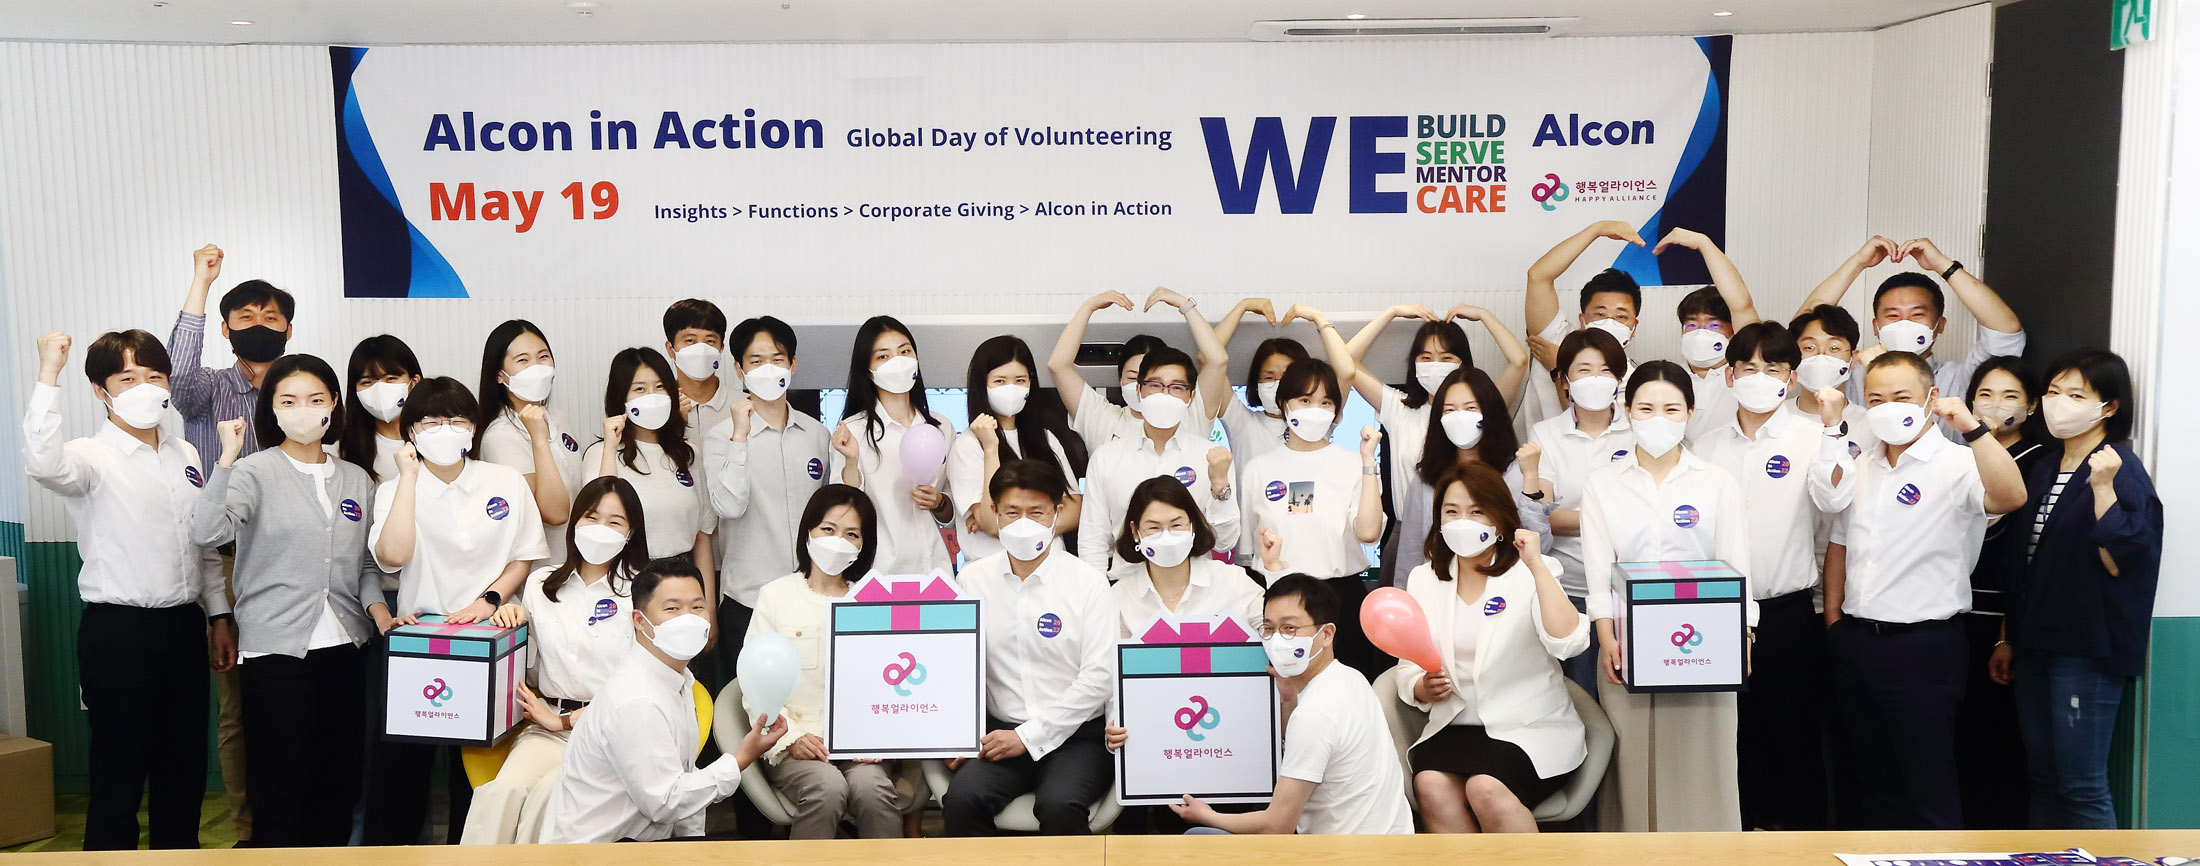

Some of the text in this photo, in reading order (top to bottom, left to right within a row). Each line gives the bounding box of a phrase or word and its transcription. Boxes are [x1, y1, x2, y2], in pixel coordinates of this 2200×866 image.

[423, 108, 823, 152] Alcon in Action
[1417, 114, 1506, 139] BUILD
[1532, 113, 1655, 147] Alcon
[846, 126, 1173, 153] Global Day of Volunteering
[1199, 115, 1408, 215] WE
[1416, 140, 1505, 165] SERVE
[1416, 166, 1507, 184] MENTOR
[1575, 179, 1658, 194] 행복얼라이언스
[429, 181, 620, 234] May 19
[1416, 185, 1507, 214] CARE
[1609, 194, 1657, 202] ALLIANCE
[654, 203, 728, 224] Insights
[748, 203, 839, 219] Functions
[859, 203, 952, 222] Corporate
[957, 201, 1015, 221] Giving
[1034, 200, 1086, 217] Alcon
[1091, 200, 1108, 216] in
[1113, 200, 1172, 216] Action
[871, 702, 939, 715] 행복얼라이언스
[1163, 748, 1233, 760] 행복얼라이언스
